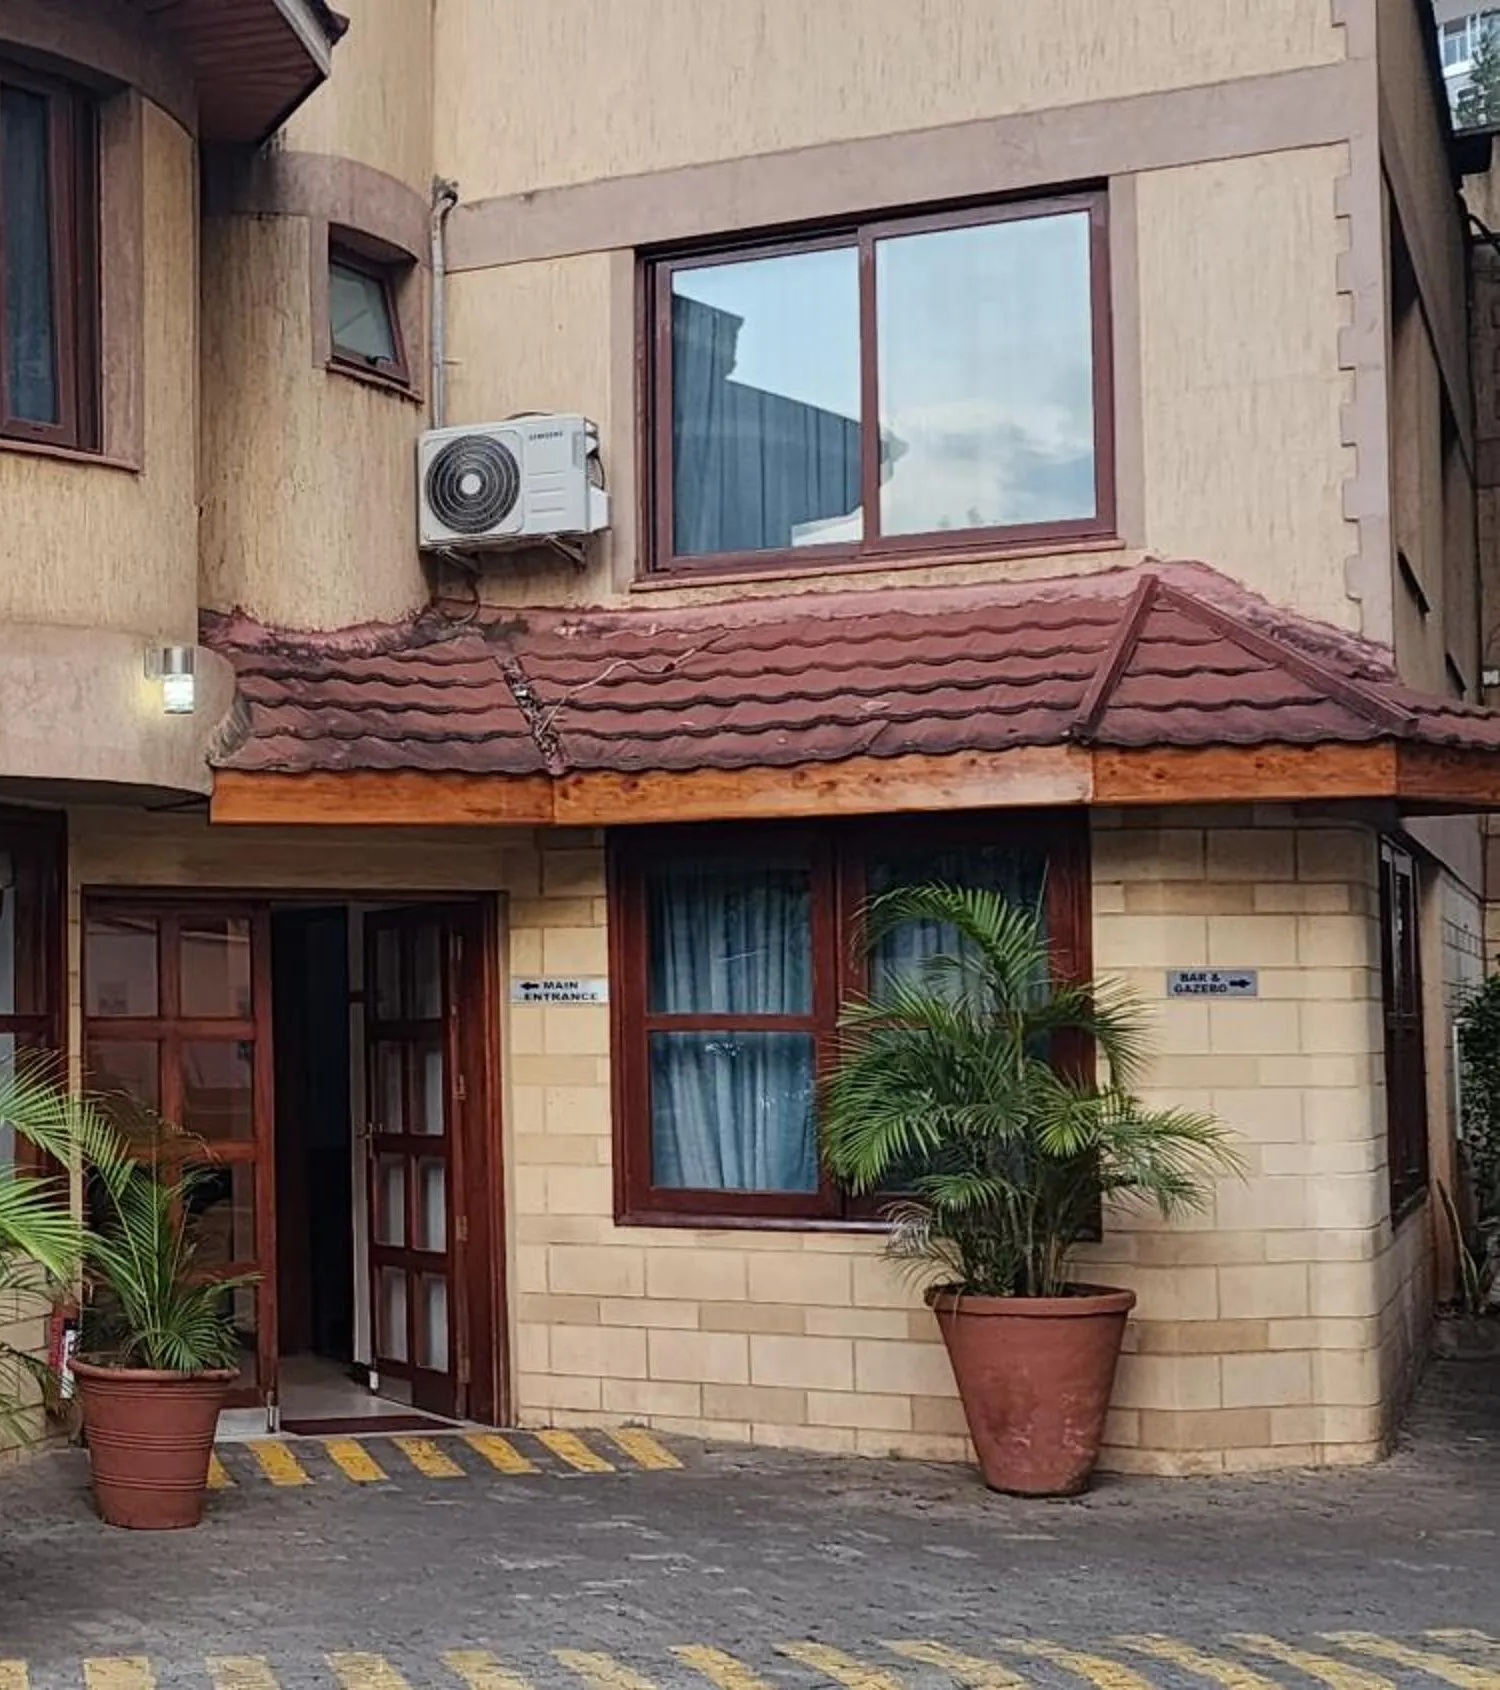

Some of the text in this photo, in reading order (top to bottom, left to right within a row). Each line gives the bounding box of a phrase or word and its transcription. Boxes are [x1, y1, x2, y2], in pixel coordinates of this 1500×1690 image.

[1180, 973, 1221, 982] BAR &
[543, 981, 579, 990] MAIN
[1173, 984, 1228, 993] GAZEBO
[524, 992, 598, 1001] ENTRANCE
